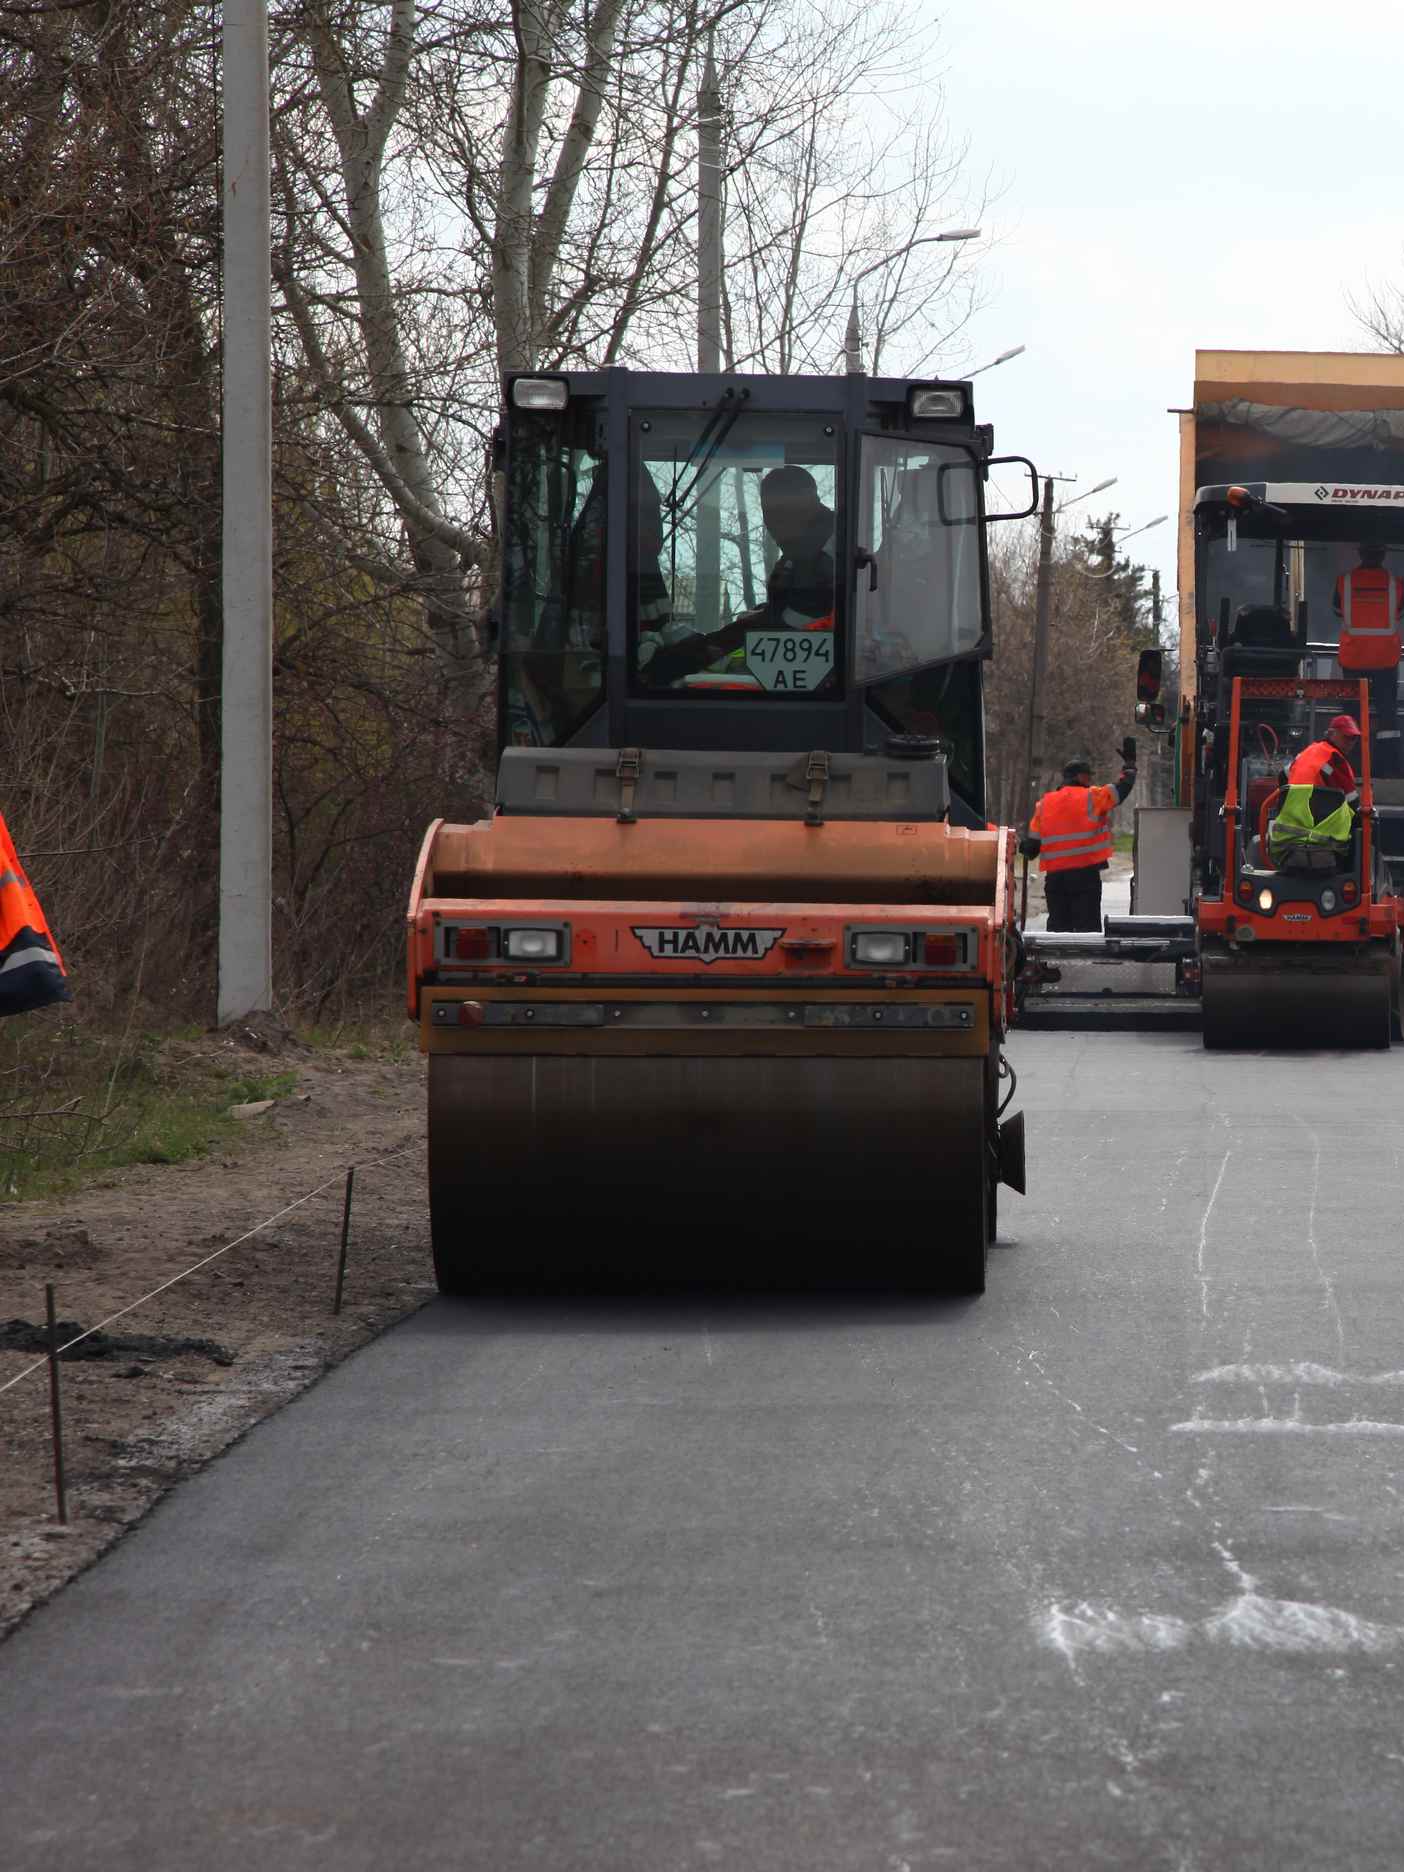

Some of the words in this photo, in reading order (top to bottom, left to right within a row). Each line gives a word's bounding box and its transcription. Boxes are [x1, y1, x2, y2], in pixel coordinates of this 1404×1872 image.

[751, 638, 829, 663] 47894
[773, 669, 807, 689] AE
[658, 931, 759, 955] HAMM
